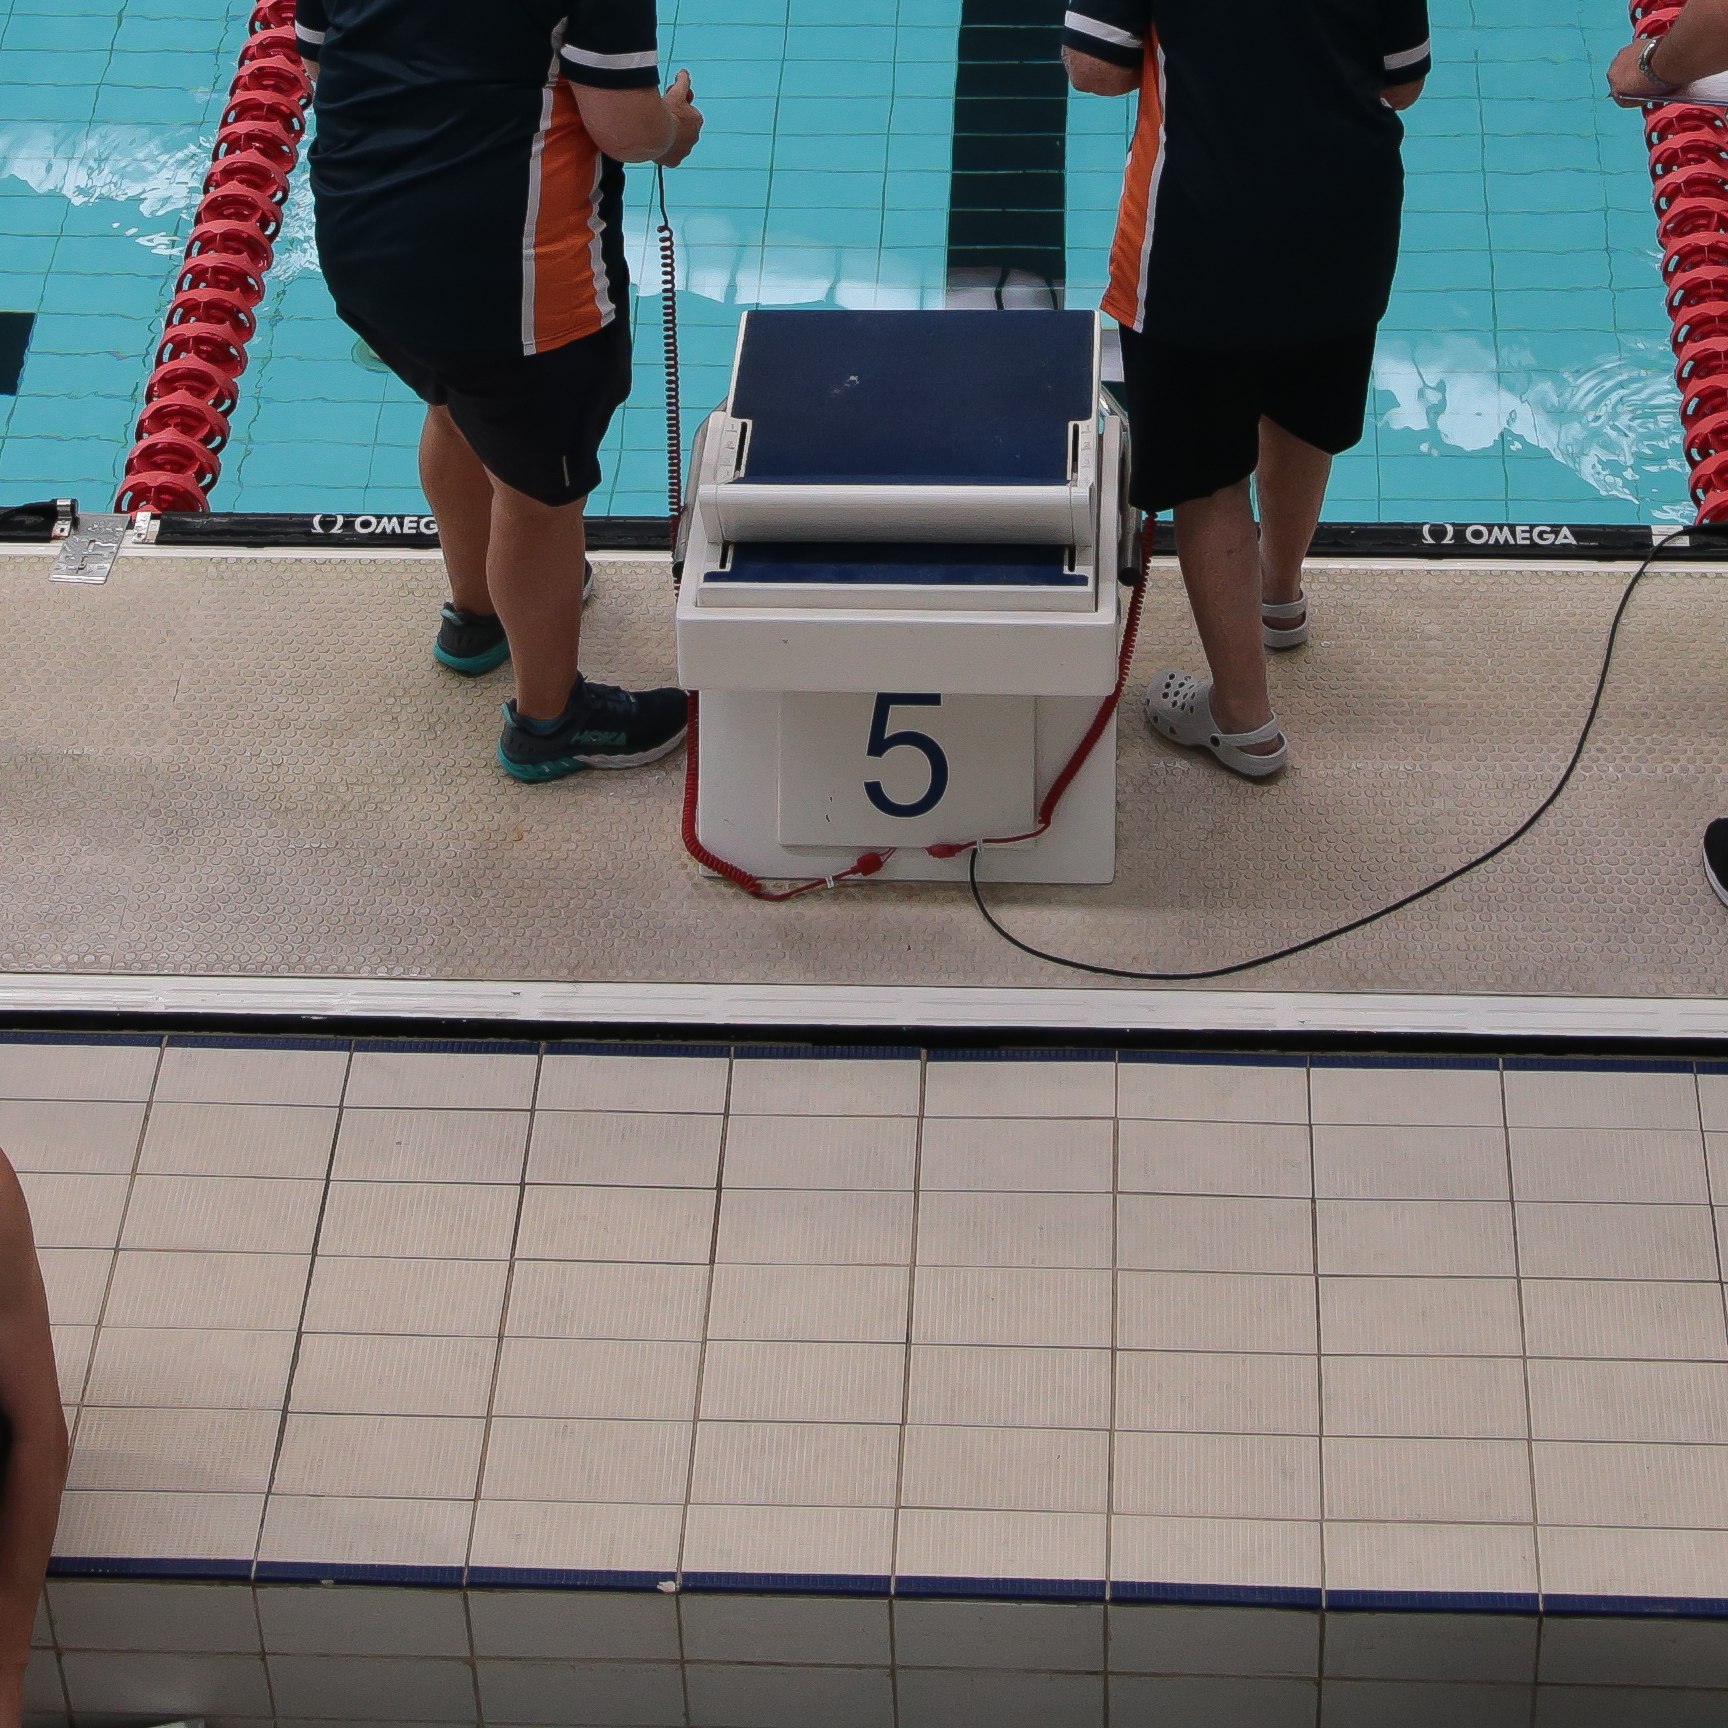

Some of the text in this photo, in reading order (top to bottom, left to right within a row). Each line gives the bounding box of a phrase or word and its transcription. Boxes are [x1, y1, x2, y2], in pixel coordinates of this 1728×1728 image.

[354, 515, 439, 534] OMEG
[1465, 524, 1577, 545] OMEGA
[862, 692, 949, 819] 5
